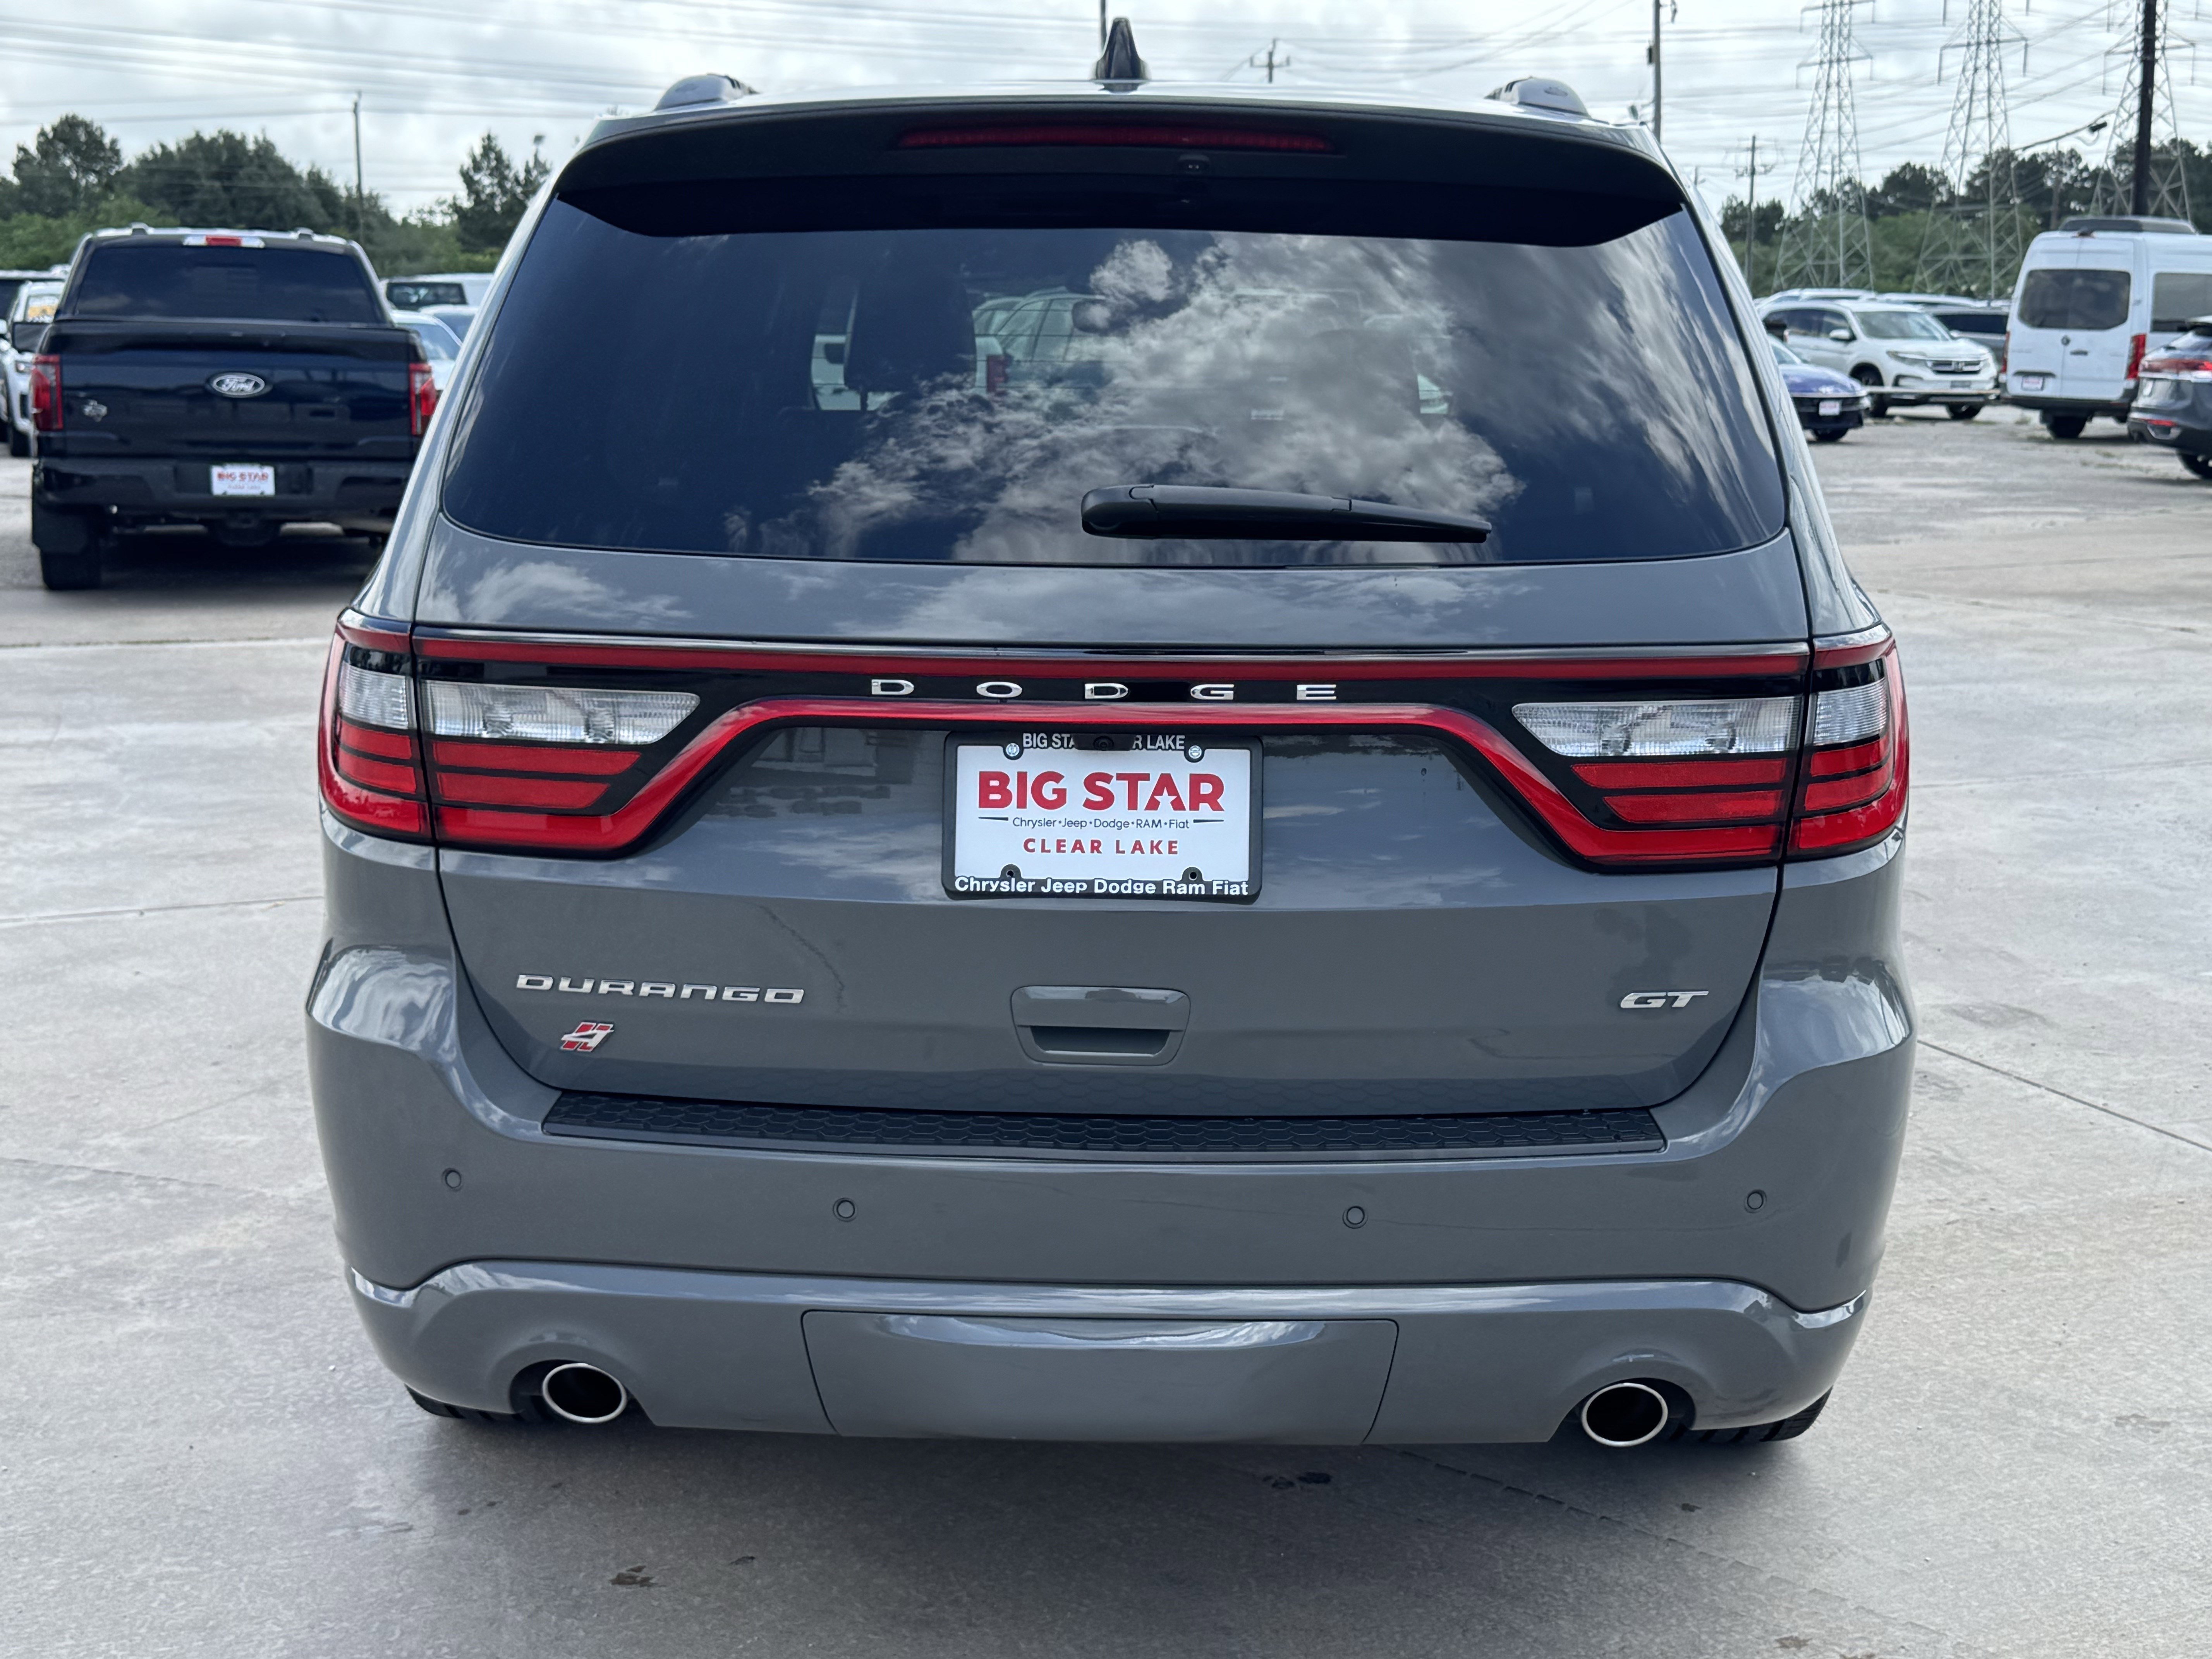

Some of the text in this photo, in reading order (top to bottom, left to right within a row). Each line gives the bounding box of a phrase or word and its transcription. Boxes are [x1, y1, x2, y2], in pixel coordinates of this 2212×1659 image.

[871, 679, 1337, 700] DODGE
[1023, 733, 1048, 748] BIG
[1051, 733, 1075, 748] STA
[1147, 735, 1185, 749] LAKE
[979, 771, 1224, 812] BIG STAR
[1012, 817, 1190, 830] Chrysler Jeep Dodge RAM Fiat
[1023, 838, 1178, 855] CLEAR LAKE
[955, 877, 1249, 895] Chrysler Jeep Dodge Ram Fiat
[516, 974, 804, 1003] DURANGO
[1620, 991, 1709, 1008] GT
